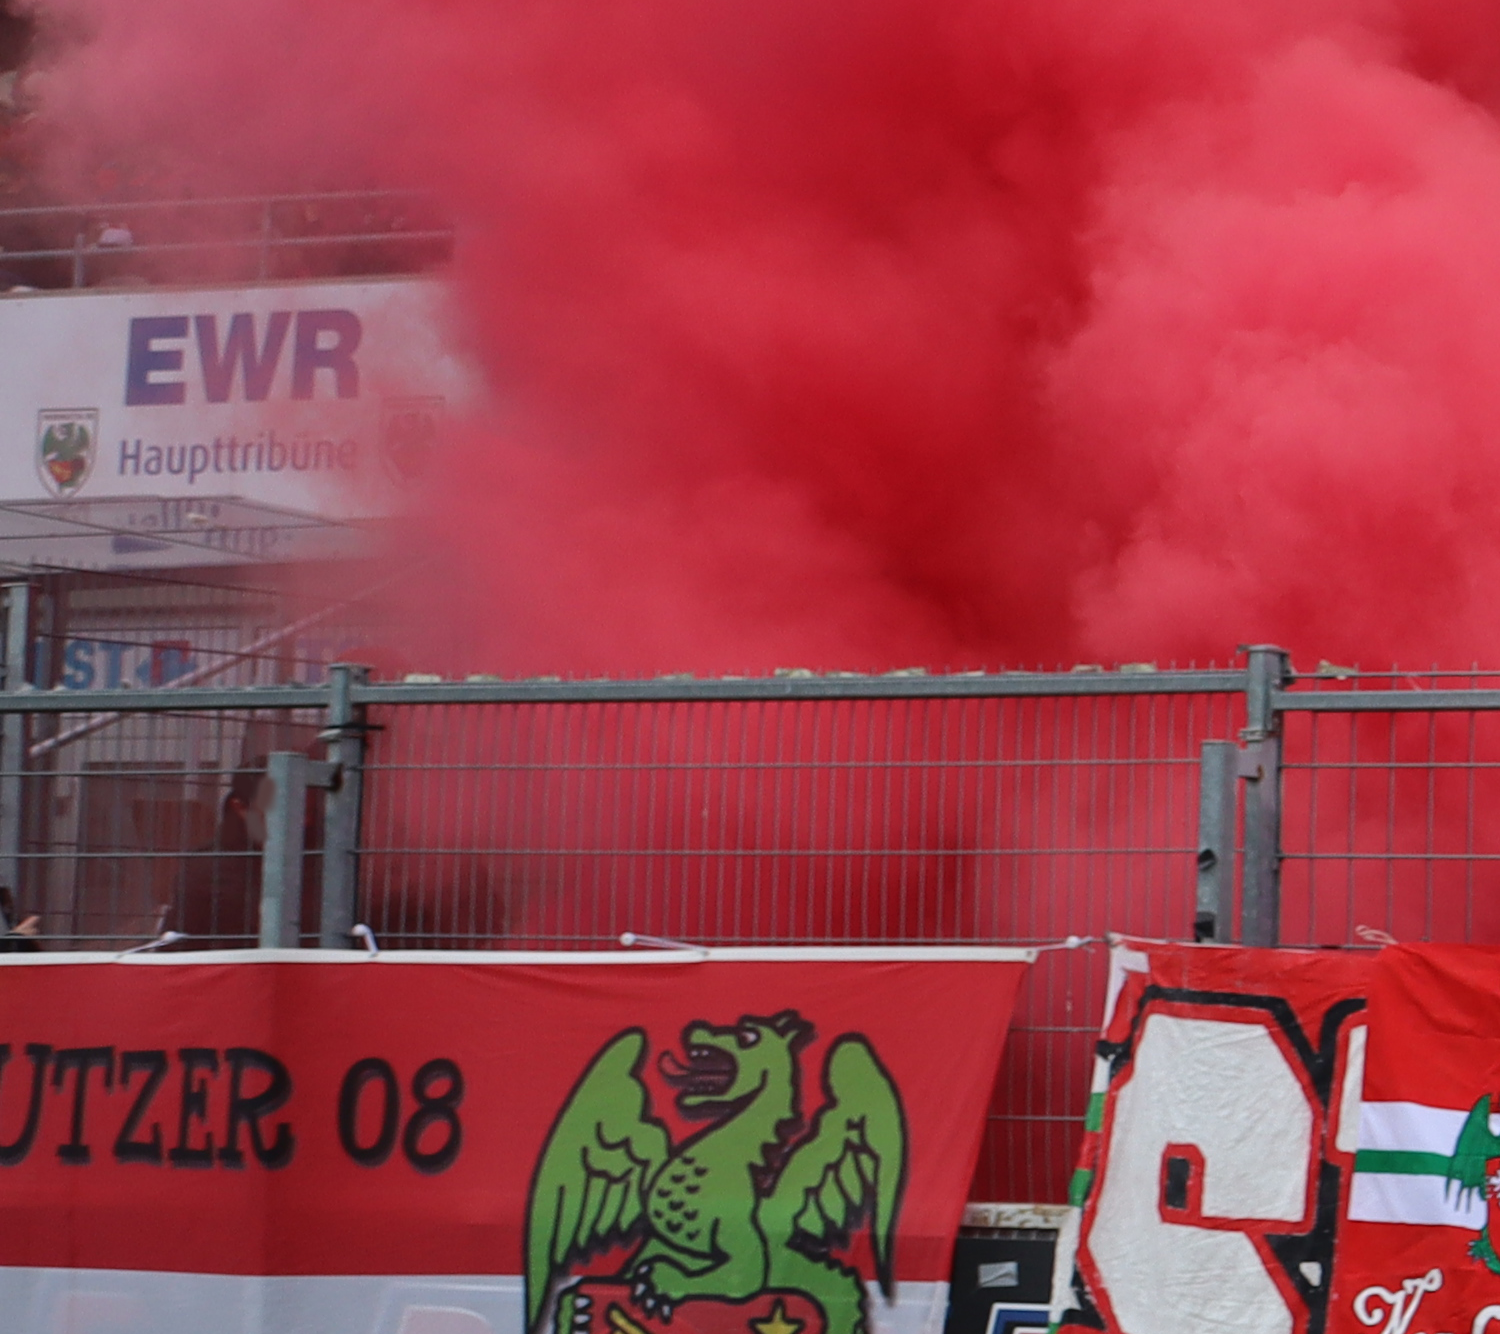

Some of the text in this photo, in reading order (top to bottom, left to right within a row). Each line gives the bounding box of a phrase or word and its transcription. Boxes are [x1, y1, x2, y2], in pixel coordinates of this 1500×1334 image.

[124, 309, 363, 406] EWR
[118, 431, 356, 484] Haupttribüne
[337, 1056, 465, 1174] 08
